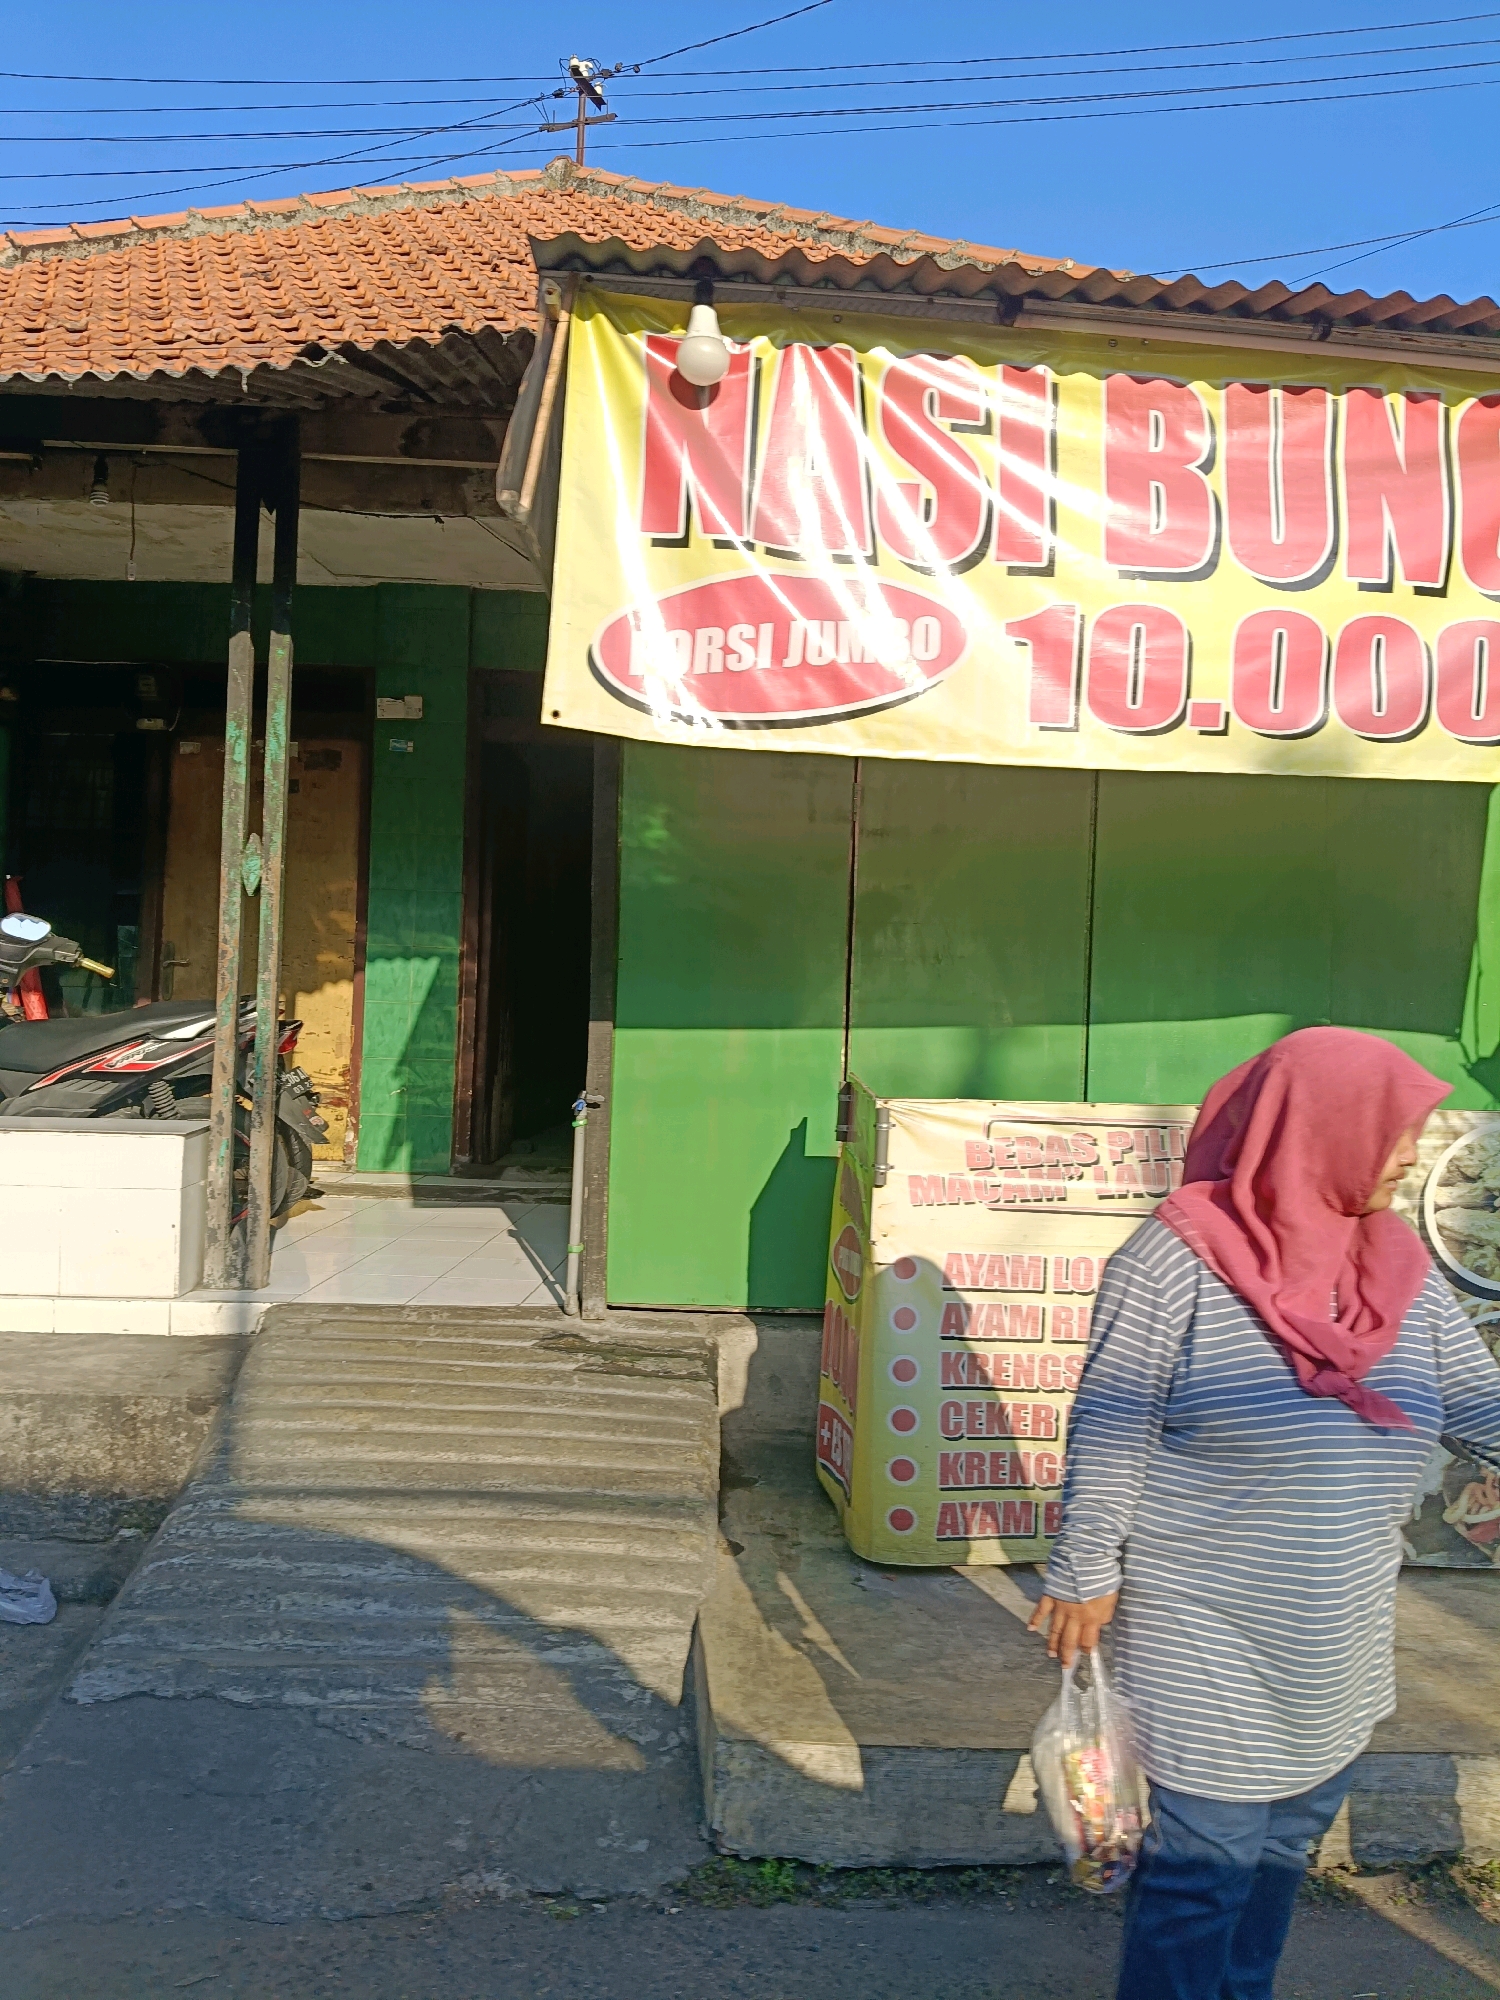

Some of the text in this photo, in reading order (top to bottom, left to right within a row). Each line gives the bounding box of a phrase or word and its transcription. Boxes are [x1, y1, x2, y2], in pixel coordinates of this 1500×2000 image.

[641, 331, 1053, 573] NASI
[1005, 604, 1500, 742] 10.000
[965, 1132, 1101, 1170] BEBAS
[941, 1251, 1047, 1294] AYAM
[939, 1301, 1045, 1343] AYAM
[940, 1350, 1085, 1393] KRENGS
[939, 1399, 1058, 1441] CEKER
[938, 1450, 1066, 1491] KRENG
[936, 1500, 1038, 1541] AYAM
